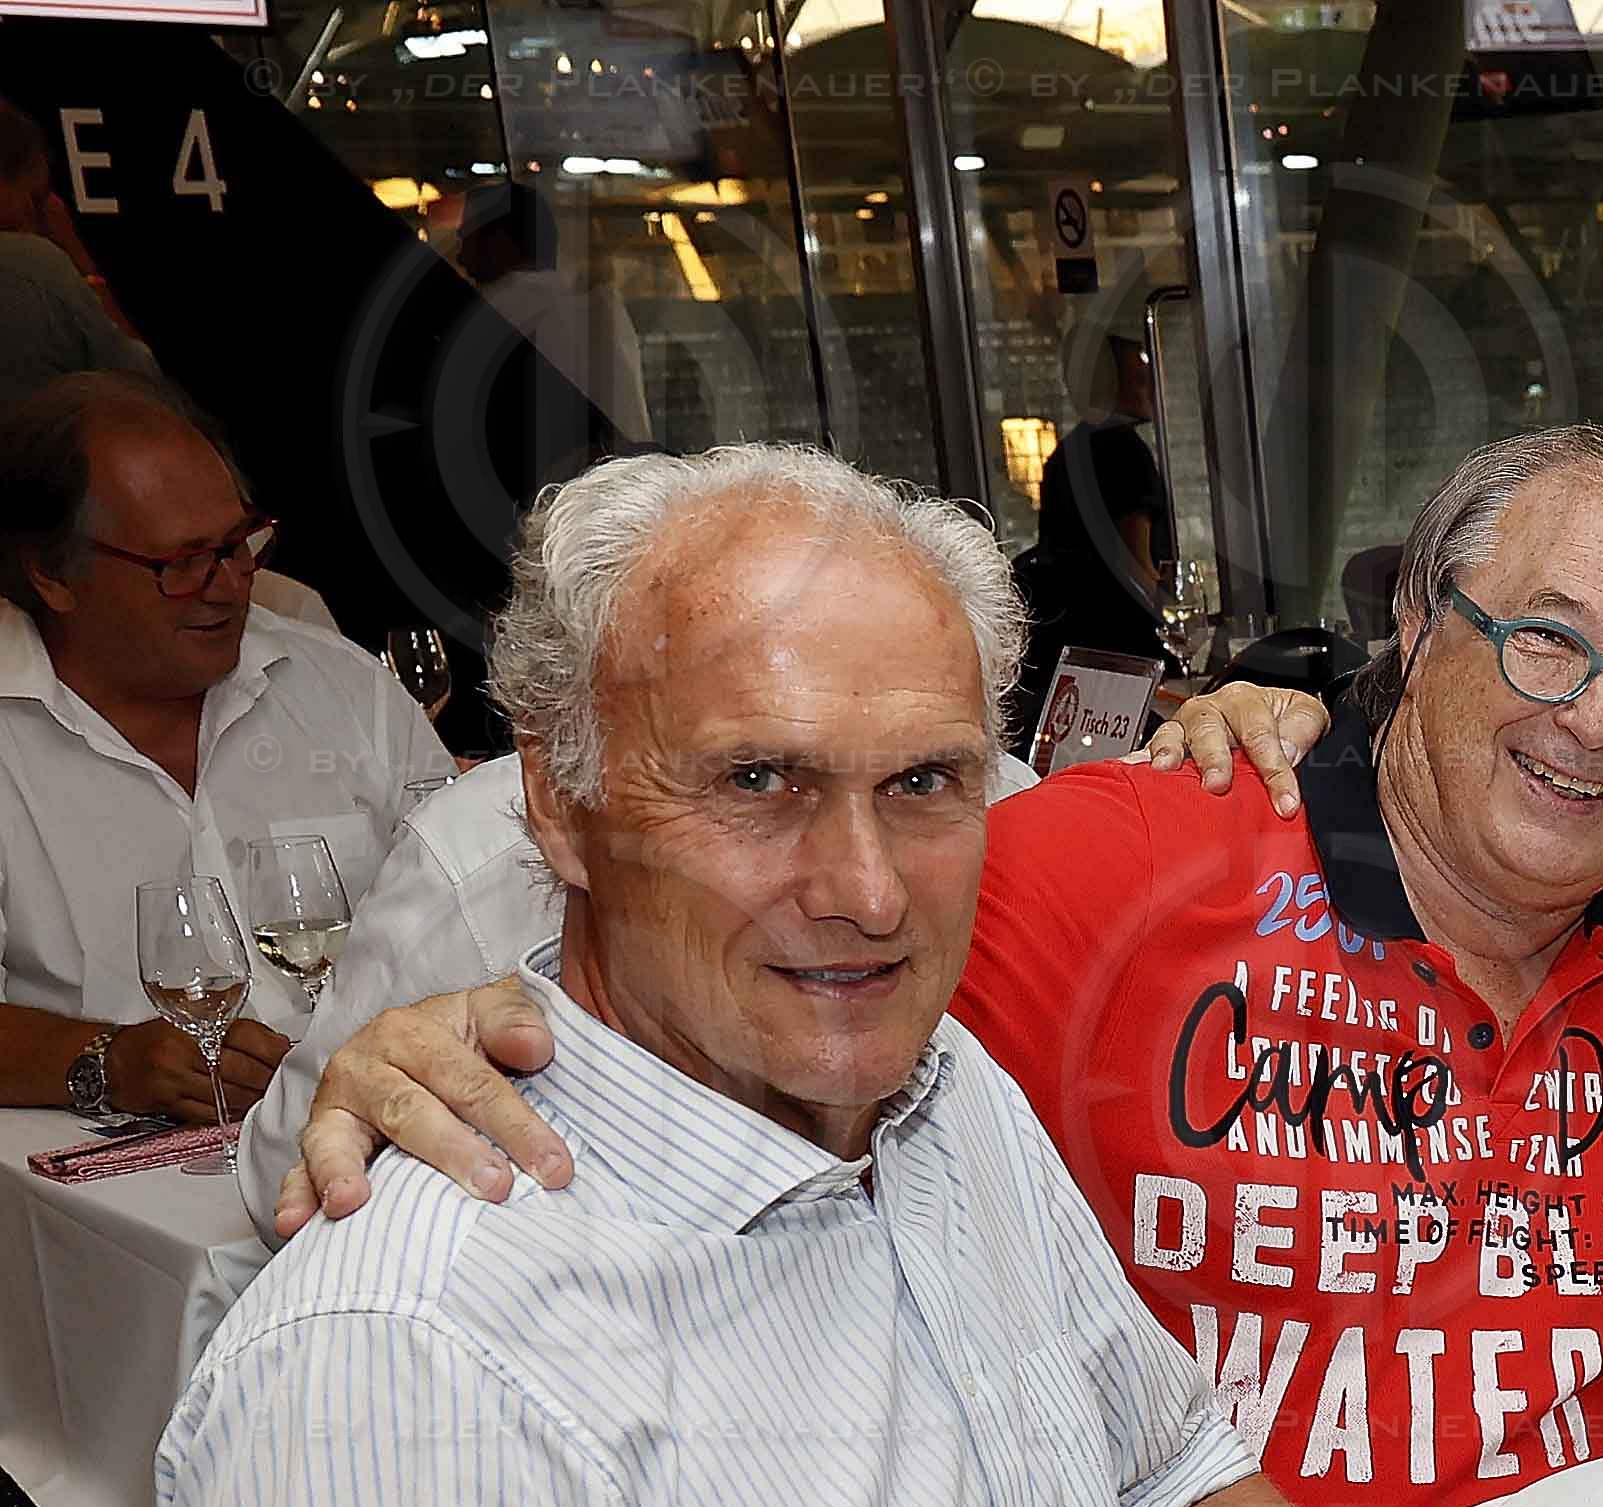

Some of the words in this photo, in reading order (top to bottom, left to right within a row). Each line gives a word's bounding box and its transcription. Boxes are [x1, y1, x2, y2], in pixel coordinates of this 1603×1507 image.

[60, 108, 118, 214] E
[173, 108, 227, 213] 4
[1080, 708, 1109, 736] Tisch
[1110, 714, 1130, 739] 23
[1169, 981, 1453, 1181] Camp
[1227, 1110, 1308, 1159] AND
[1133, 1172, 1449, 1296] DEEP
[1326, 1217, 1410, 1245] TIME
[1427, 1219, 1459, 1246] OF
[1478, 1180, 1586, 1216] HEIGHT
[1190, 1303, 1603, 1486] WATER
